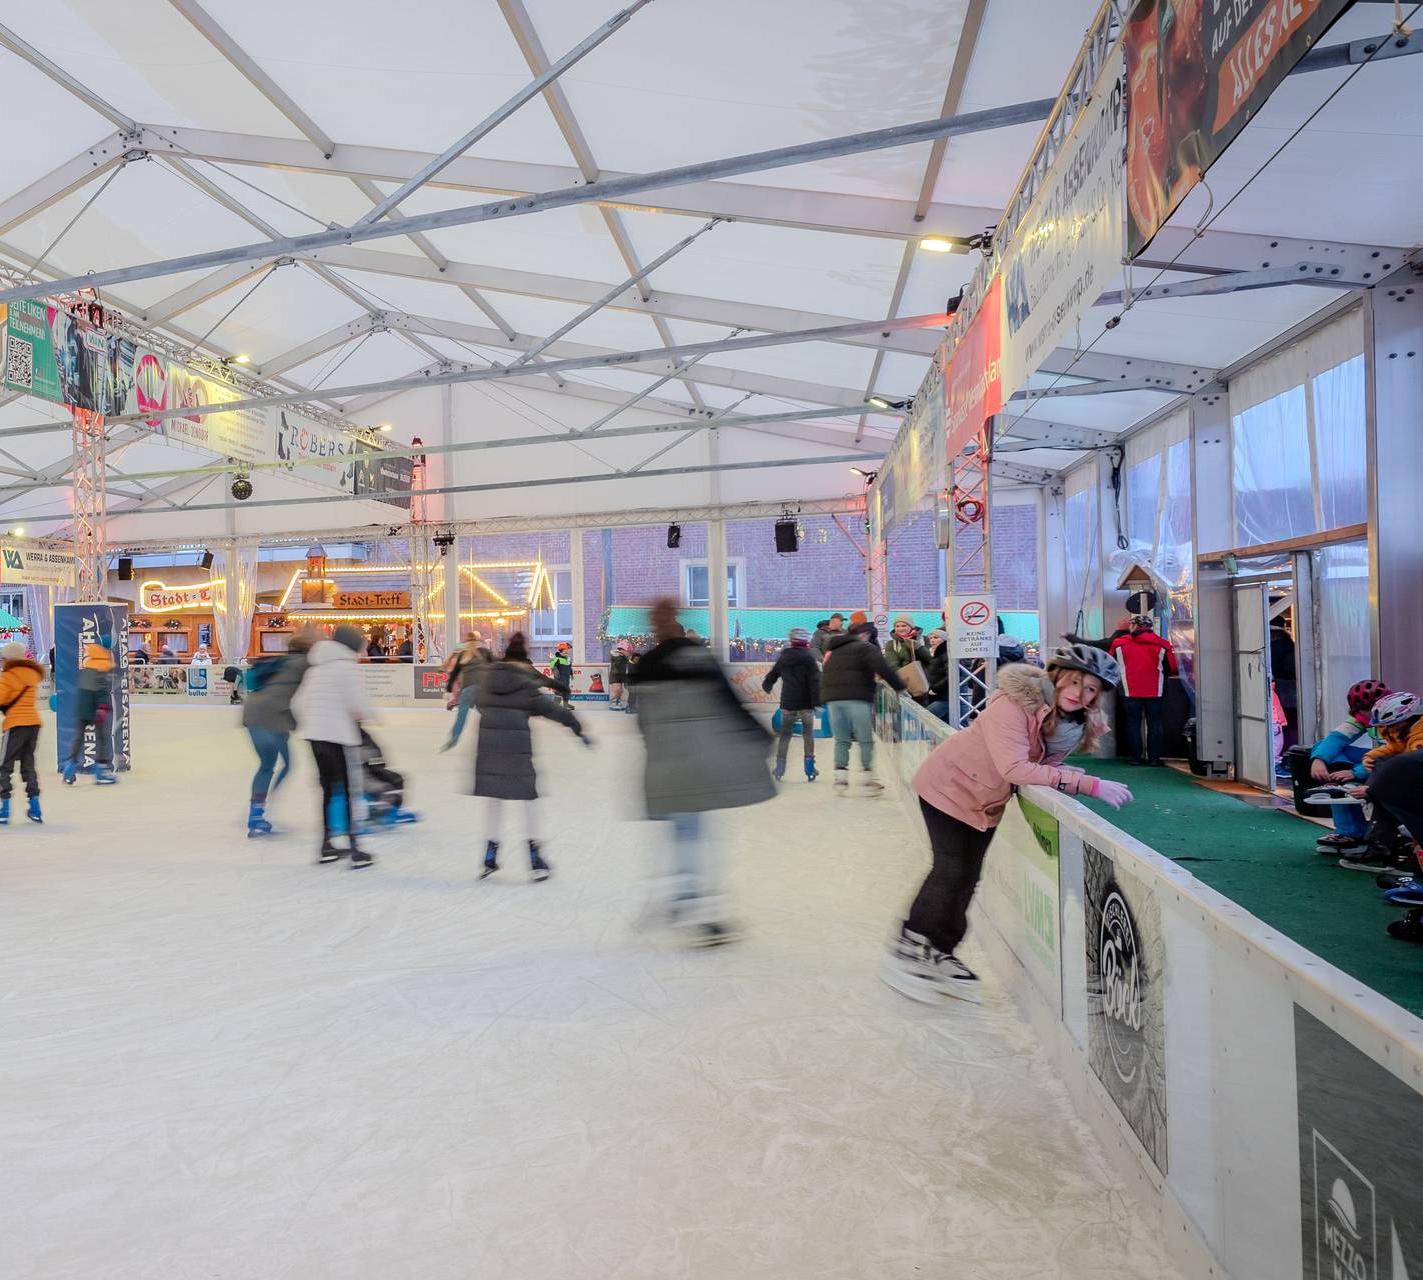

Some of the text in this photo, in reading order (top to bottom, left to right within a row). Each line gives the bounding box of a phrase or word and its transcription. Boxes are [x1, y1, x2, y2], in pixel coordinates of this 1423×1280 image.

[1230, 4, 1277, 106] ALLES
[27, 302, 46, 321] LIKEN
[26, 551, 43, 561] WERRA
[339, 591, 402, 607] Stadt-Treff
[1324, 1216, 1367, 1280] MEZZO
